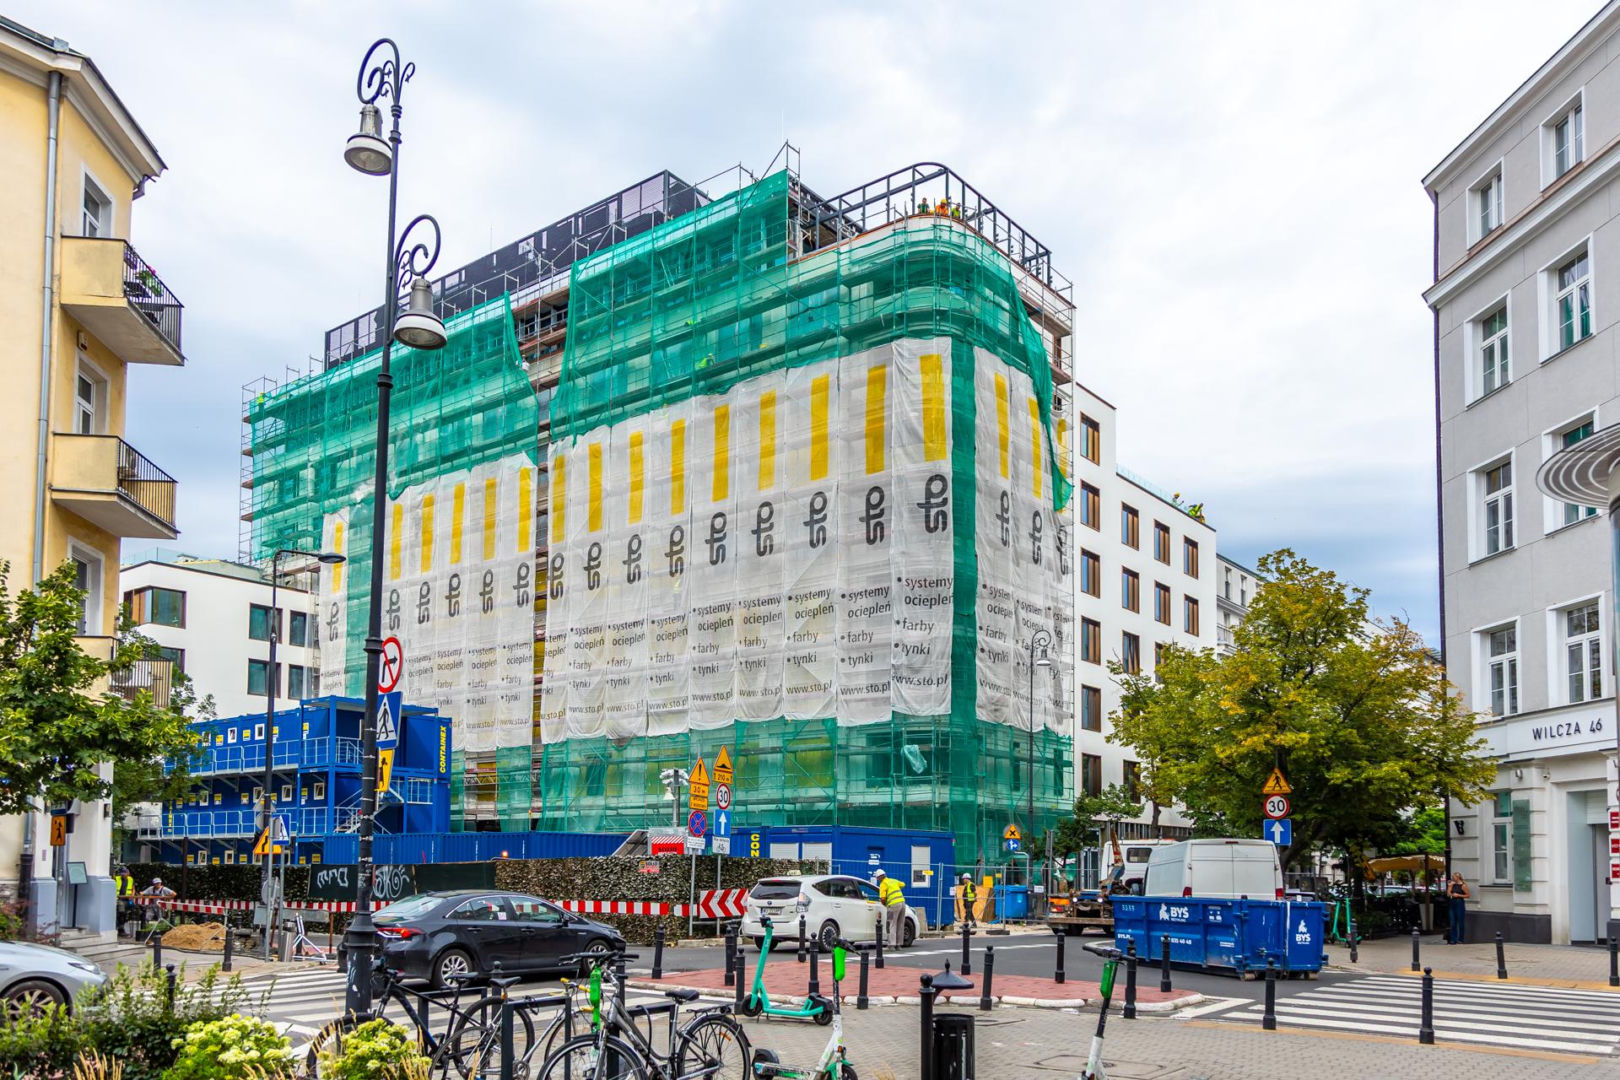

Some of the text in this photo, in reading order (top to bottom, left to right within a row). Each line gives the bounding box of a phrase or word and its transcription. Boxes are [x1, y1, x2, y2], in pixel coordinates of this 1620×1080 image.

[917, 474, 948, 533] sto
[803, 491, 827, 549] sto
[859, 486, 885, 545] sto
[996, 490, 1010, 548] sto
[751, 501, 774, 557] sto
[705, 511, 727, 565] sto
[1028, 510, 1042, 567] sto
[664, 525, 684, 577] sto
[584, 542, 602, 590] sto
[622, 534, 642, 584] sto
[513, 562, 529, 608] sto
[905, 576, 953, 591] systemy
[445, 573, 461, 617] sto
[479, 569, 494, 614] sto
[794, 588, 831, 604] systemy
[848, 585, 890, 602] systemy
[416, 581, 430, 624] sto
[697, 602, 731, 616] systemy
[743, 595, 781, 609] systemy
[386, 589, 400, 631] sto
[795, 604, 834, 620] ociepleń
[848, 601, 891, 619] ociepleń
[326, 602, 339, 641] sto
[612, 618, 644, 631] systemy
[657, 614, 685, 628] systemy
[698, 615, 733, 632] ociepleń
[902, 618, 934, 634] farby
[575, 625, 602, 636] systemy
[656, 627, 688, 642] ociepleń
[792, 631, 818, 643] farby
[848, 630, 873, 643] farby
[574, 639, 605, 651] ociepleń
[612, 634, 645, 647] ociepleń
[744, 636, 768, 648] farby
[437, 648, 462, 659] systemy
[697, 644, 719, 655] farby
[988, 649, 1009, 664] tynki
[611, 657, 632, 669] farby
[655, 653, 675, 664] farby
[745, 657, 766, 671] tynki
[793, 652, 817, 666] tynki
[848, 653, 873, 667] tynki
[573, 661, 592, 672] farby
[698, 663, 719, 677] tynki
[573, 680, 591, 690] tynki
[610, 677, 630, 689] tynki
[655, 673, 674, 684] tynki
[786, 680, 832, 694] www.sto.pl
[840, 680, 890, 696] www.sto.pl
[505, 692, 520, 703] tynki
[692, 688, 733, 702] www.sto.pl
[1532, 718, 1603, 740] WILCZA 46
[719, 790, 728, 803] 30
[1268, 800, 1285, 813] 30
